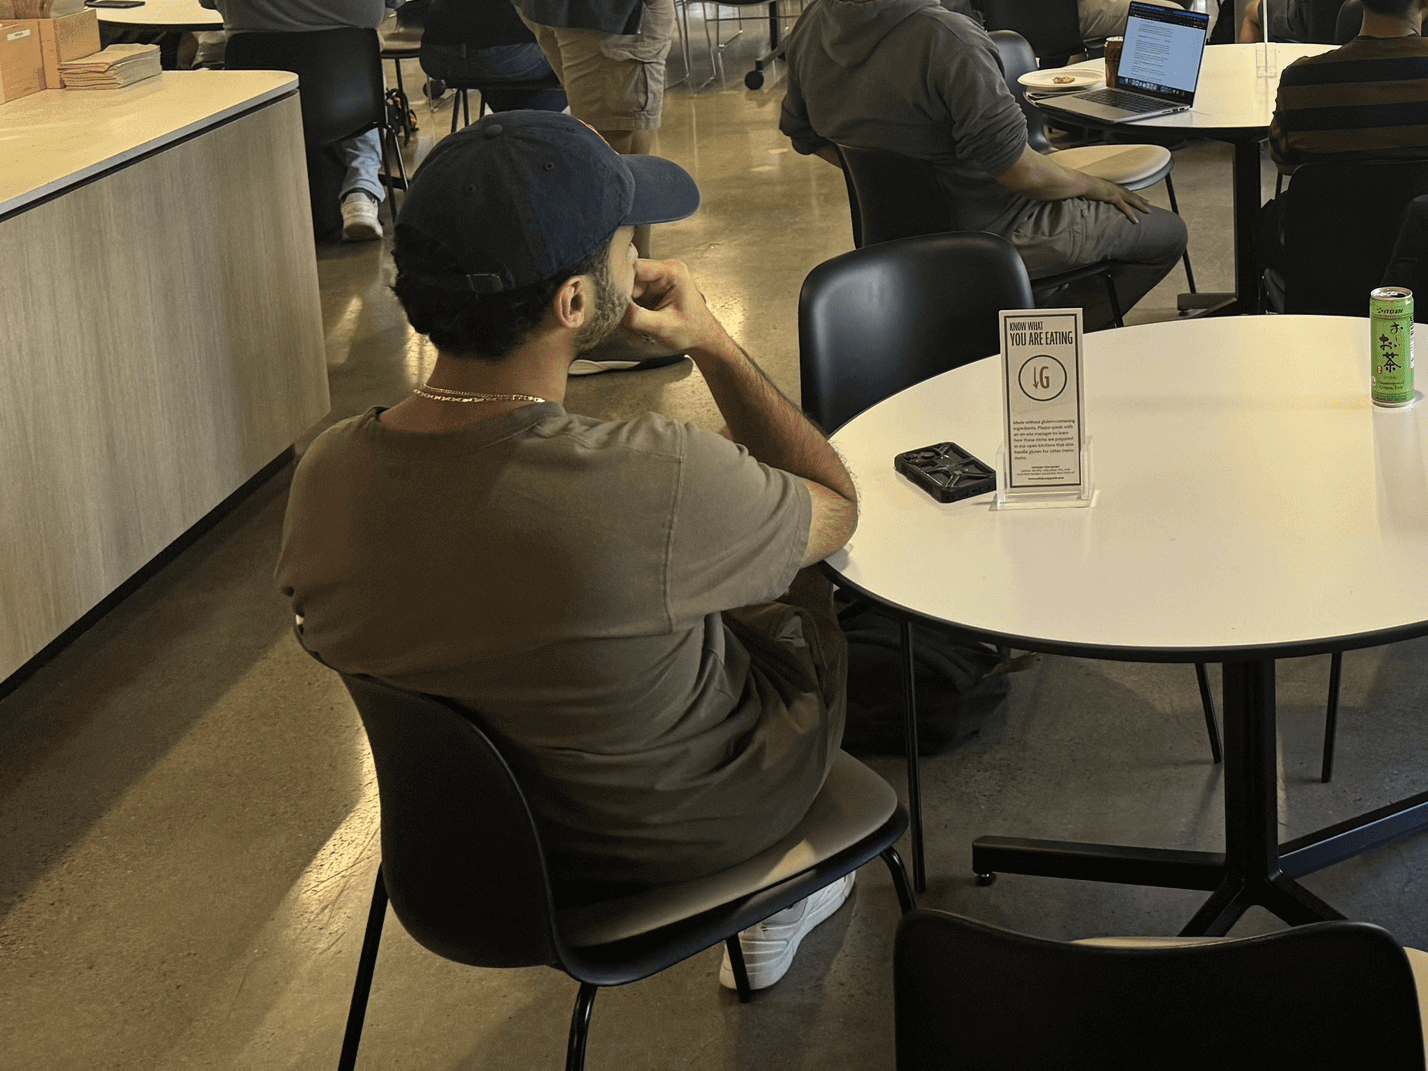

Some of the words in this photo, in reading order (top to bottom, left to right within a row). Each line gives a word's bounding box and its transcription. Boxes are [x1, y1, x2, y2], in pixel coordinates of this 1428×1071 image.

[1009, 322, 1027, 331] KNOW
[1027, 321, 1043, 330] WHAT
[1010, 332, 1027, 346] YOU
[1028, 332, 1044, 345] ARE
[1045, 330, 1073, 345] EATING
